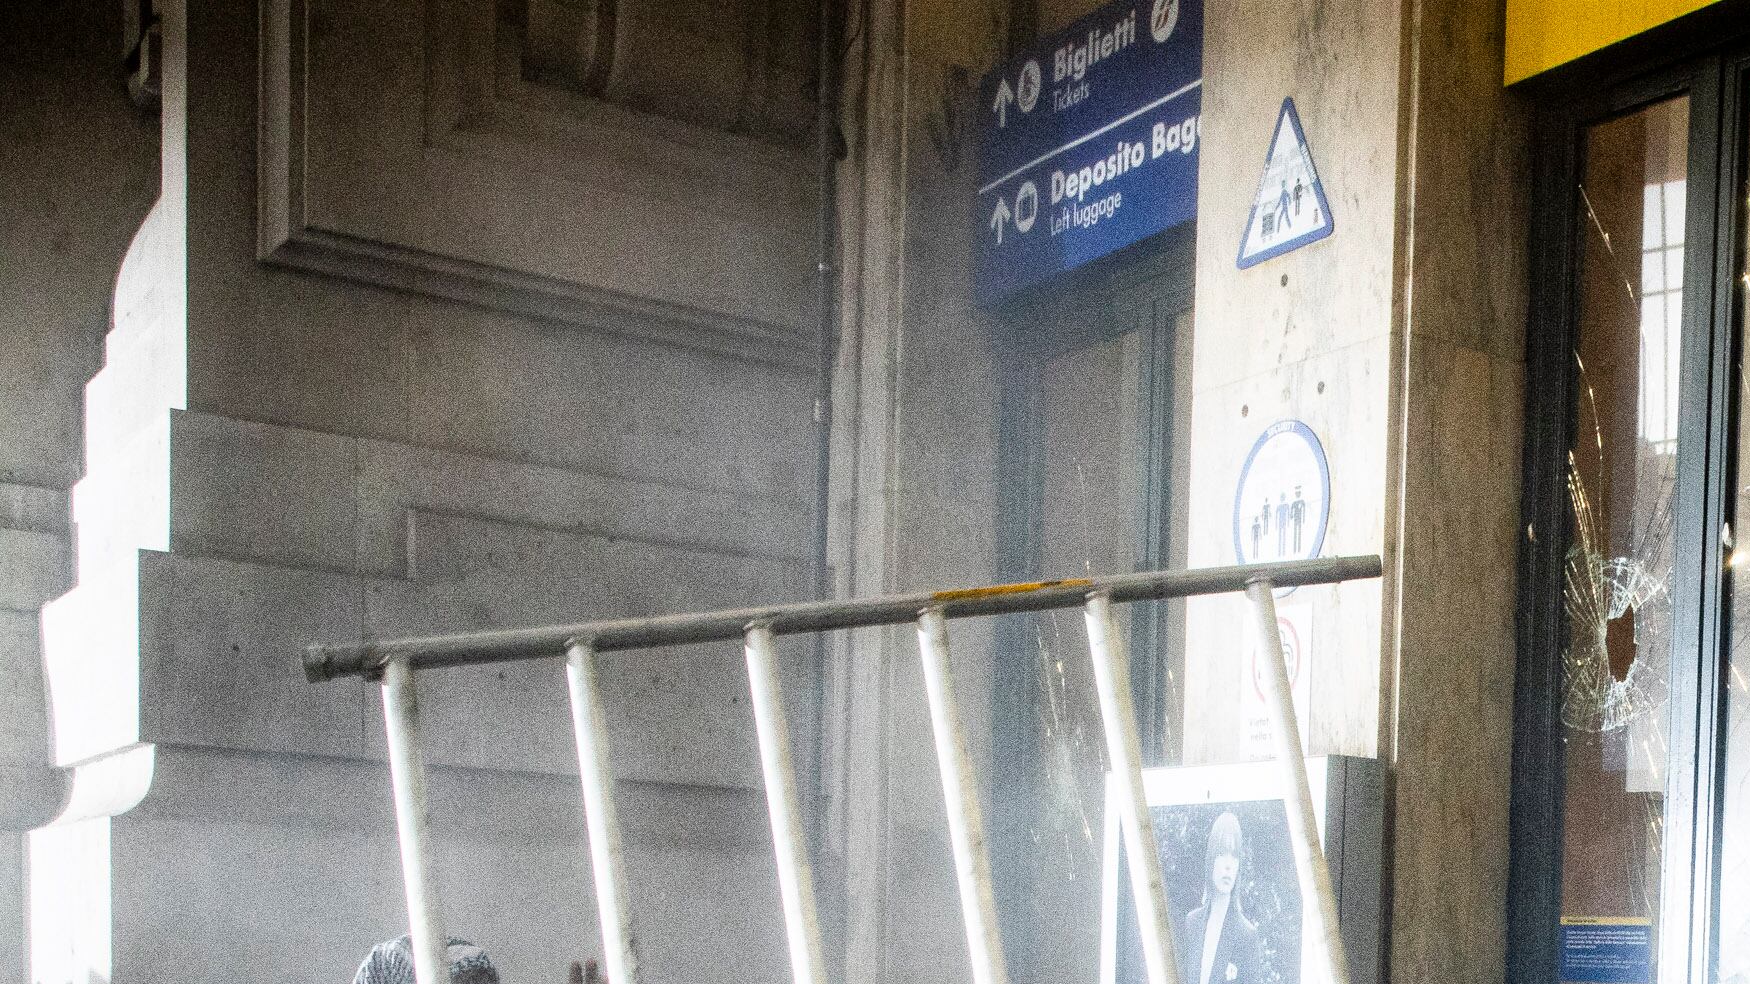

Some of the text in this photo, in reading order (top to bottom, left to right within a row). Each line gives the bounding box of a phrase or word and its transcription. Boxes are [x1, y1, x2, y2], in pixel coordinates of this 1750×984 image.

[1053, 9, 1135, 82] Biglietti
[1052, 81, 1090, 114] Tickets
[1050, 141, 1146, 206] Deposito
[1050, 192, 1122, 236] Left luggage
